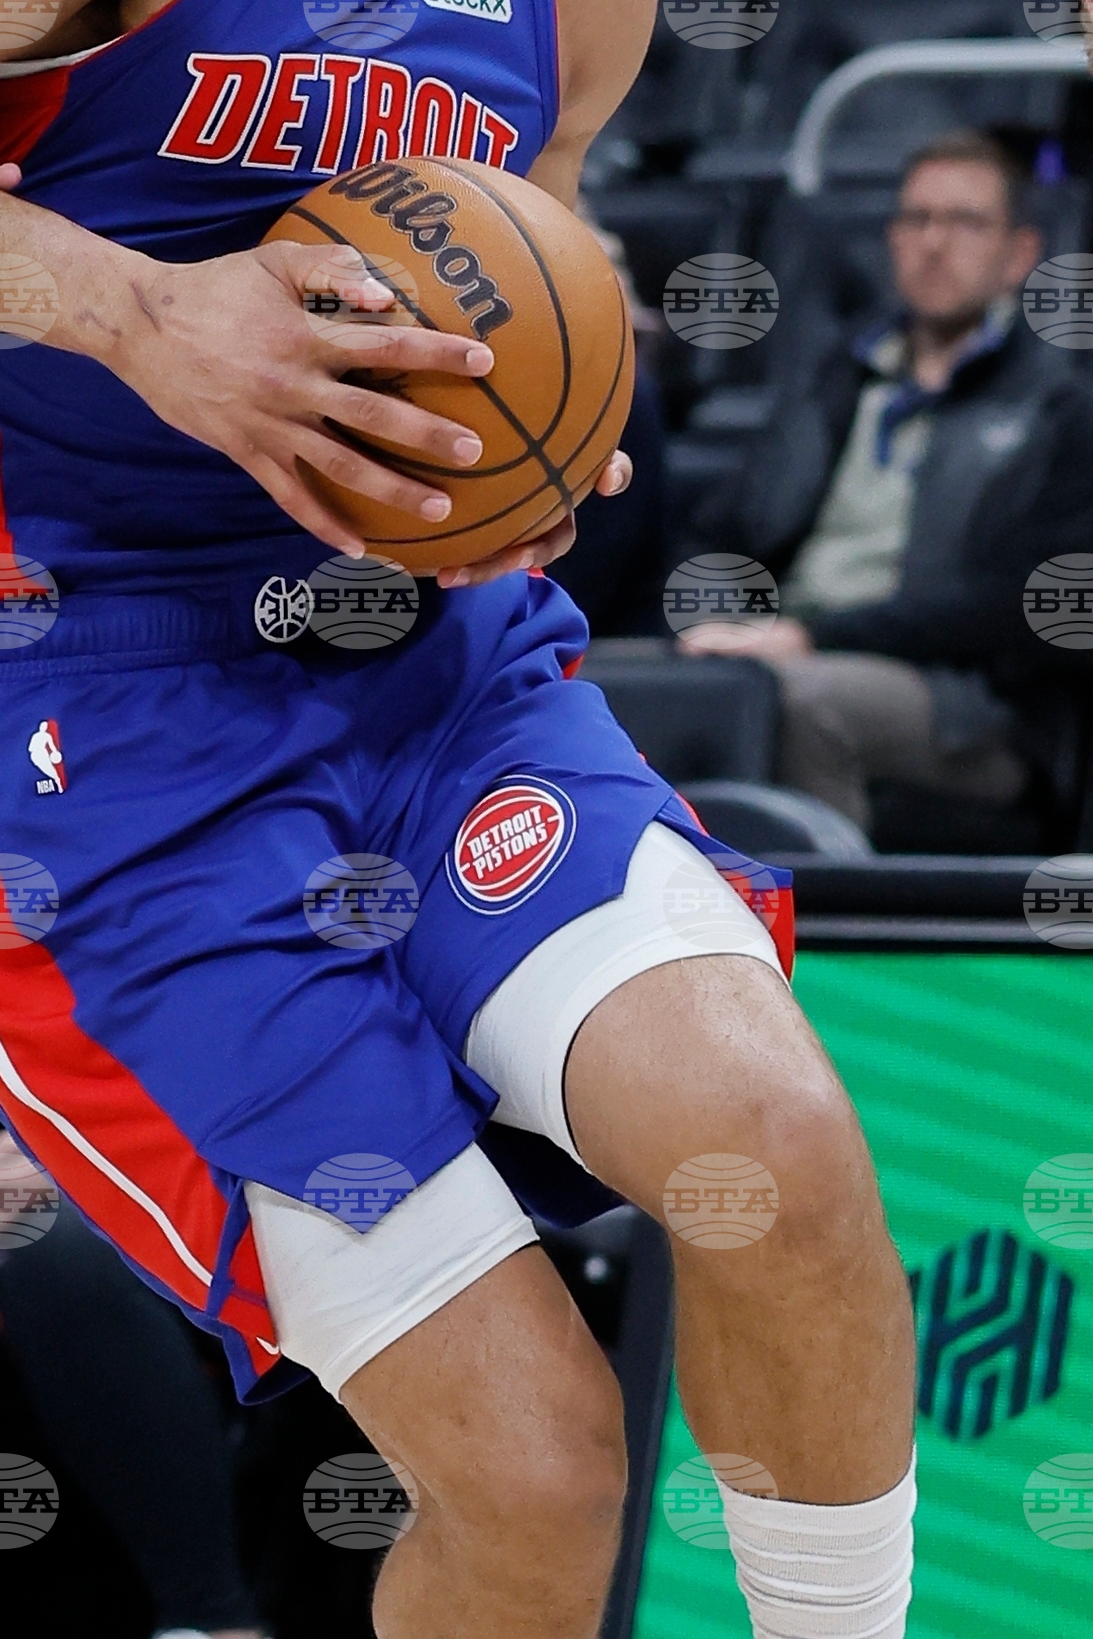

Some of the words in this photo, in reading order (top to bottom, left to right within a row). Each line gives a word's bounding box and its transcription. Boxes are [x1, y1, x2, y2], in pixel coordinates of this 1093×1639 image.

[158, 53, 519, 175] DETROIT
[328, 161, 514, 340] Wilson
[36, 779, 55, 794] NBA
[466, 804, 542, 860] DETROIT
[472, 822, 548, 880] PISTONS
